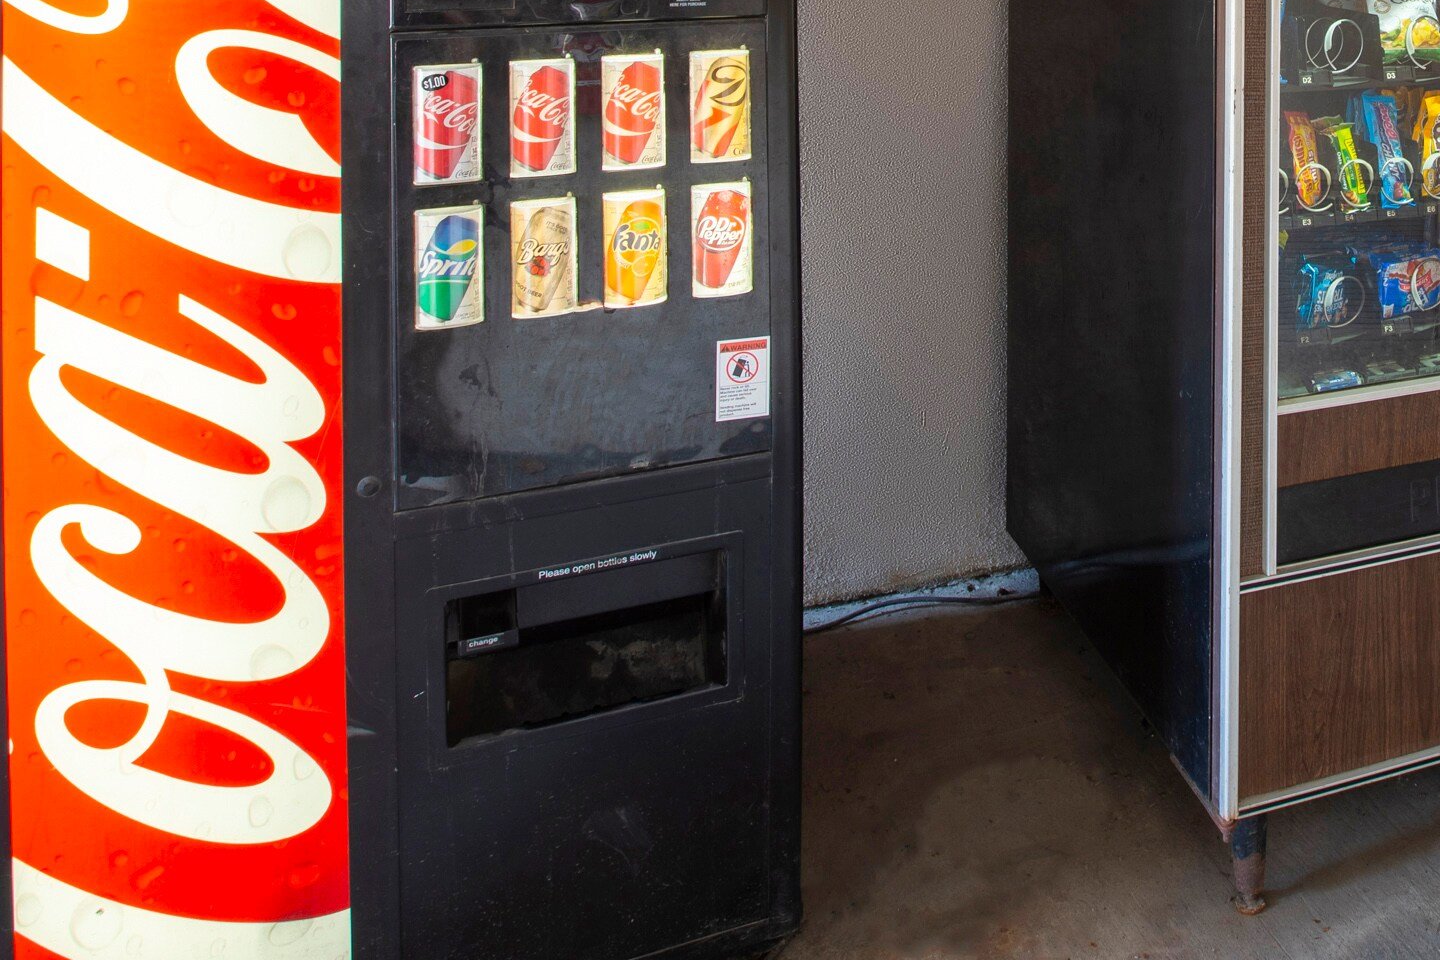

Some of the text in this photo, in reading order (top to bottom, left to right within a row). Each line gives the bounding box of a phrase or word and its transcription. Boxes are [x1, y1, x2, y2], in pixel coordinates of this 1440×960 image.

[1302, 76, 1313, 84] D2
[1386, 72, 1396, 80] D3
[423, 75, 447, 90] $1.00
[1344, 214, 1354, 222] E4
[1387, 210, 1396, 218] E5
[1302, 218, 1312, 226] E3
[698, 216, 743, 245] Pepper
[1384, 325, 1394, 333] F3
[1300, 336, 1310, 344] F2
[731, 342, 767, 352] WARNING
[538, 549, 658, 580] Please open bottles slowly
[468, 635, 499, 649] change
